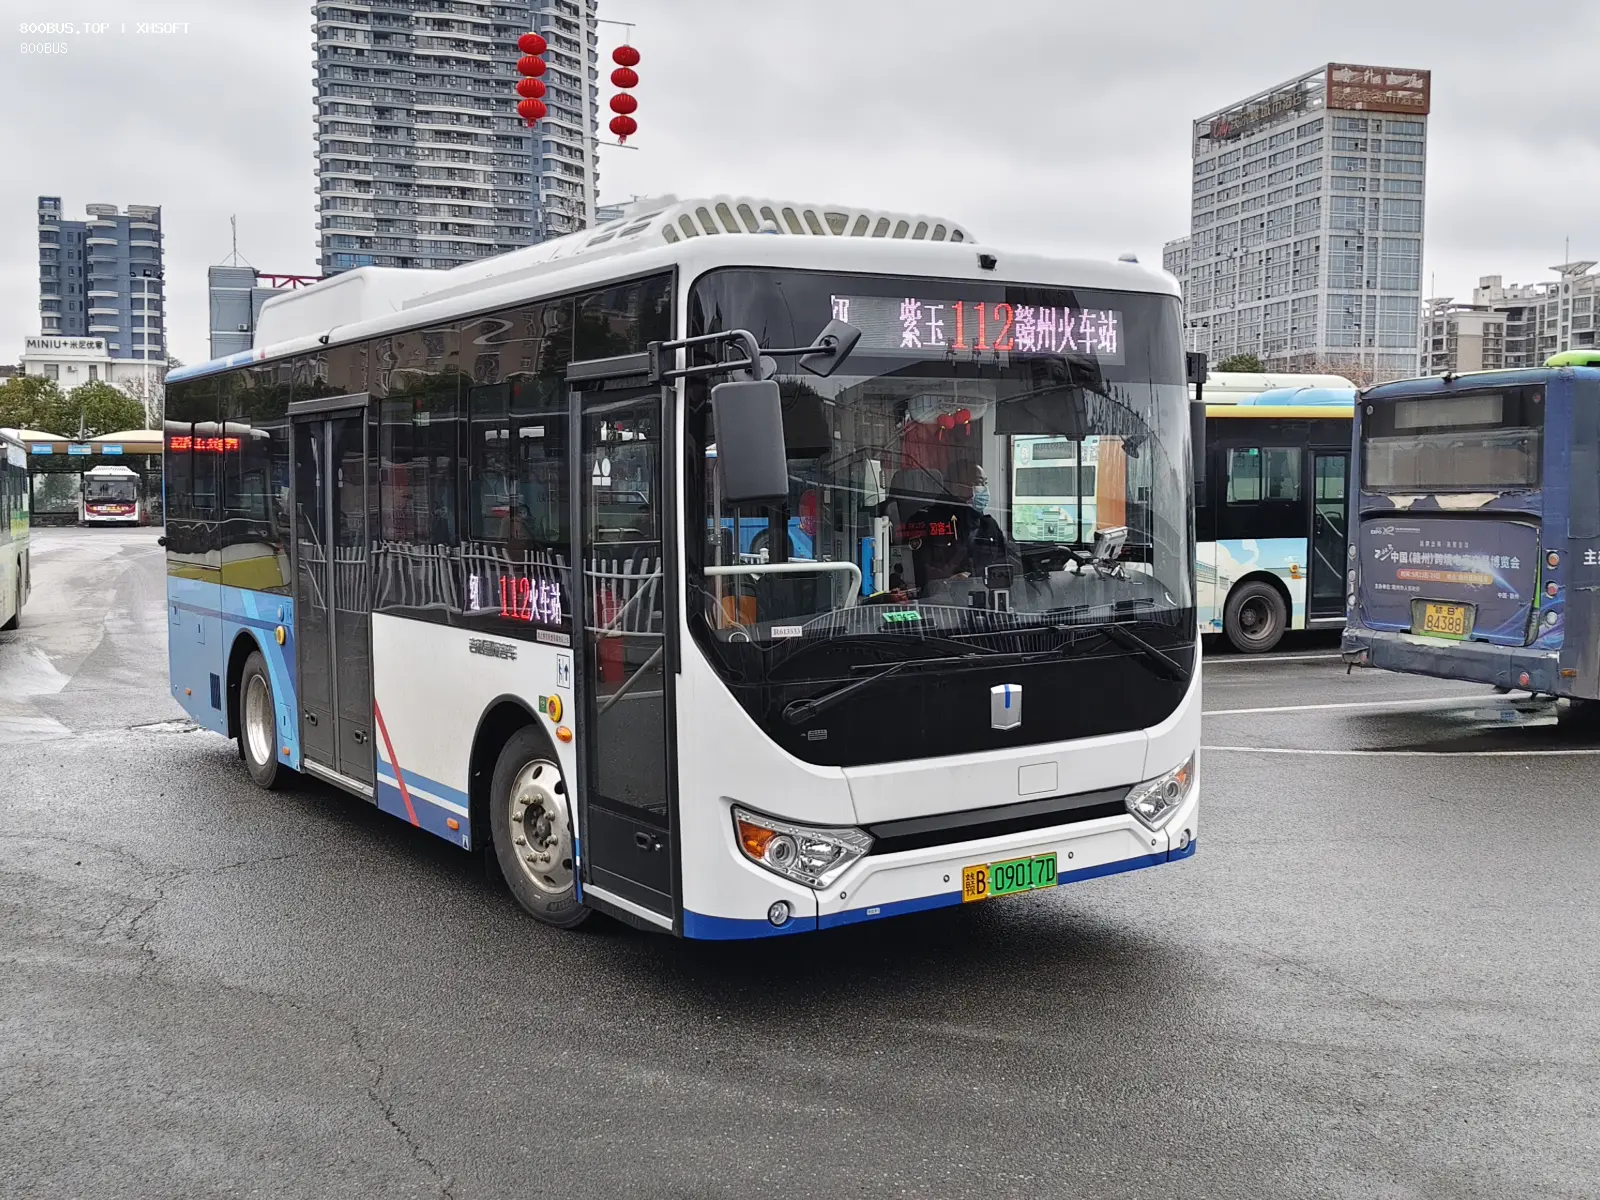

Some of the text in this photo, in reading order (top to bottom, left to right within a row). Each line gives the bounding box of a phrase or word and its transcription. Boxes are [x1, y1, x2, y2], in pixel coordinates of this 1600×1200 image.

[900, 297, 946, 348] 紫玉
[952, 300, 1014, 351] 112
[1015, 304, 1118, 354] 赣州火车站
[1583, 549, 1600, 565] 主
[500, 575, 530, 620] 112
[529, 578, 562, 624] 火车站
[1426, 614, 1462, 632] 84388
